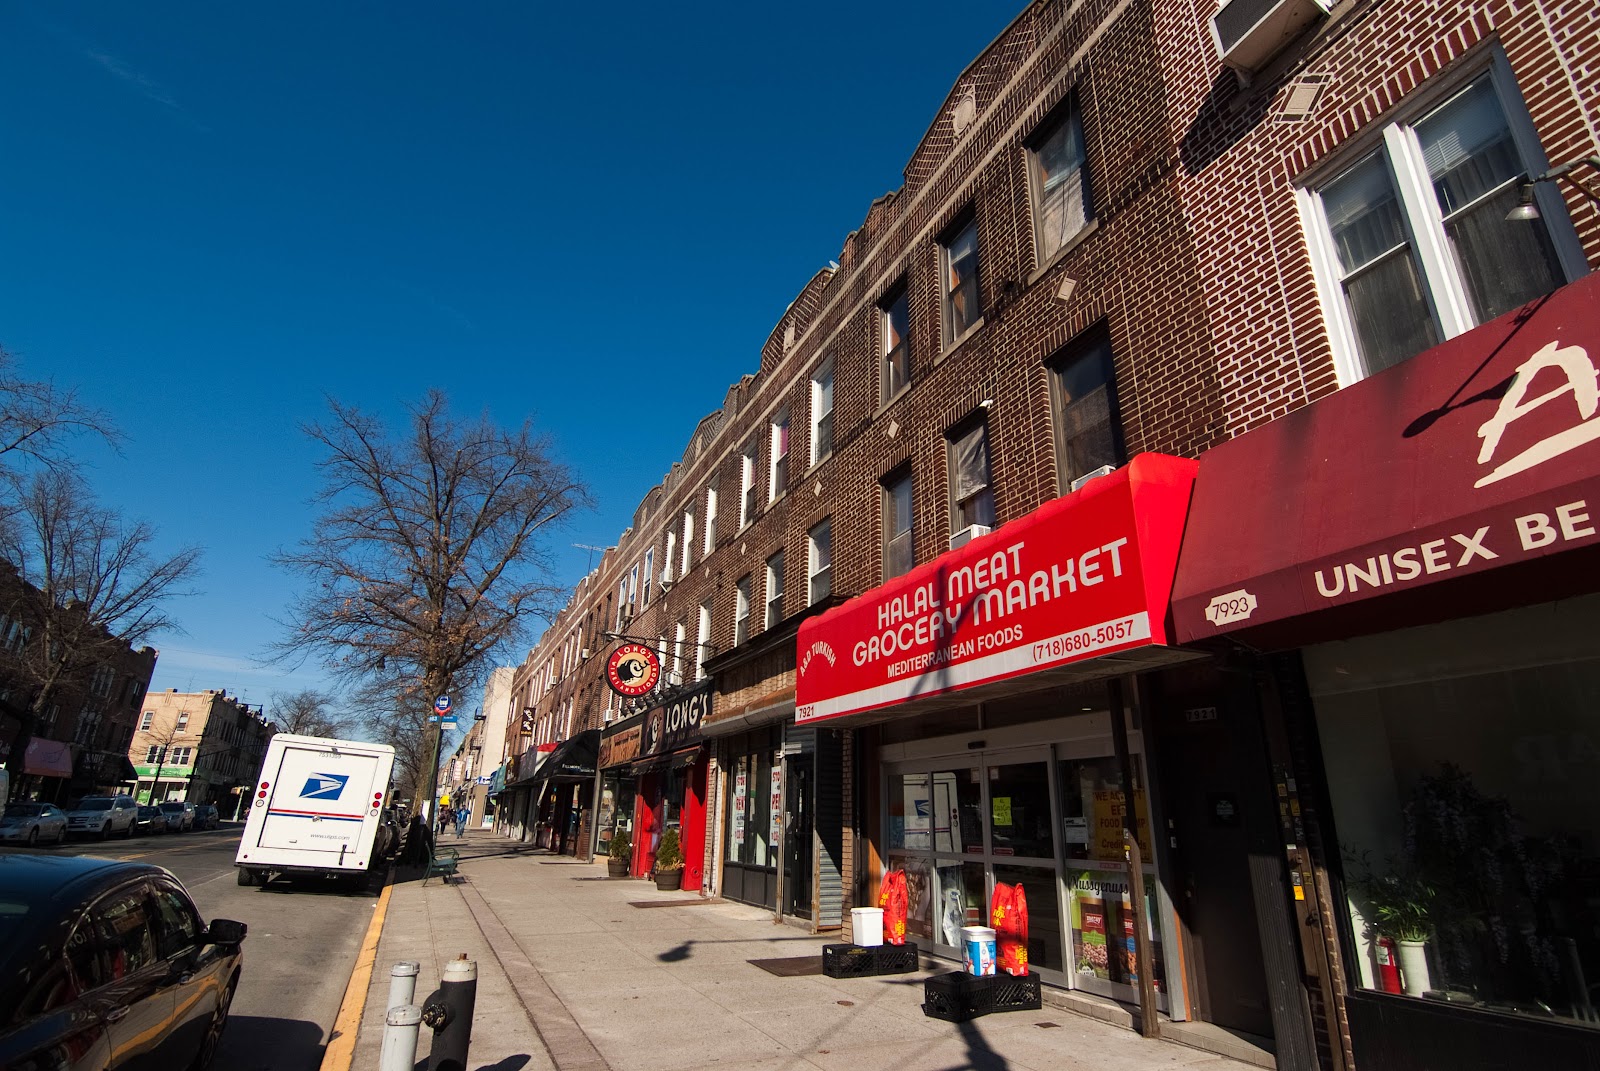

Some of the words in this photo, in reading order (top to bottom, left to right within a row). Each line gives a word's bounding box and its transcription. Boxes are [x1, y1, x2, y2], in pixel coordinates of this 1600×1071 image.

[1314, 526, 1499, 598] UNISEX
[878, 582, 941, 630] HALAL
[948, 541, 1025, 602] MEAT
[853, 603, 962, 667] GROCERY
[973, 536, 1128, 627] MARKET
[1212, 597, 1249, 620] 7923
[616, 645, 653, 659] LONG'S
[887, 639, 975, 679] MEDITERRANEAN
[977, 624, 1024, 652] FOODS
[1032, 619, 1134, 663] (718)680-5057
[800, 650, 812, 677] A&D
[812, 641, 836, 668] TURKISH
[619, 685, 635, 693] AND
[665, 692, 708, 733] LONG'S
[799, 706, 815, 718] 7921
[1186, 707, 1216, 721] 7921
[1100, 818, 1119, 828] FOOD
[1071, 875, 1129, 895] Nussgenuss
